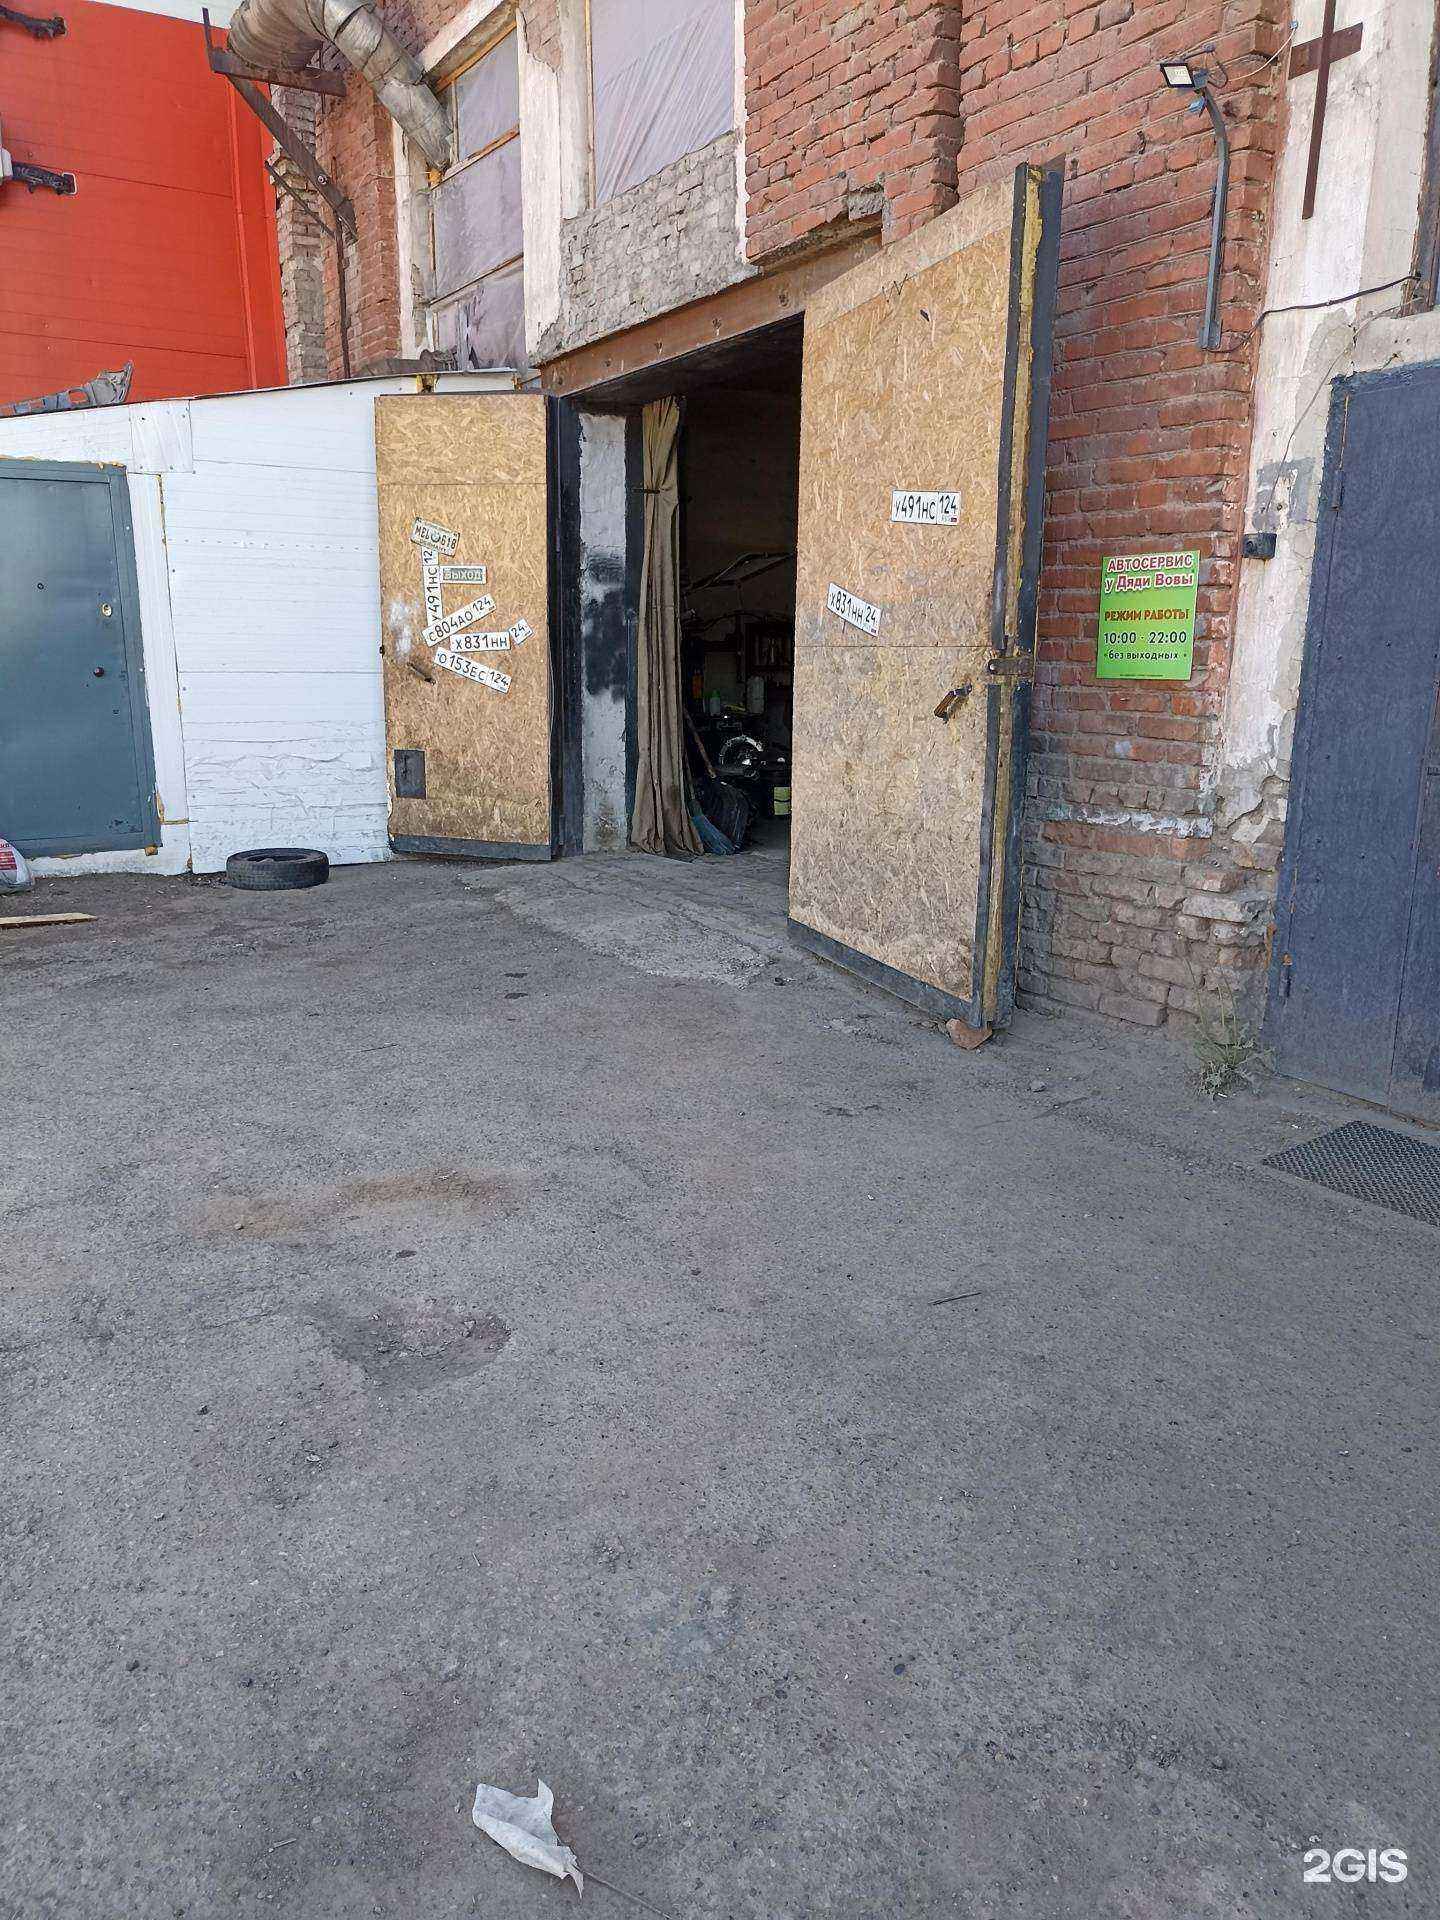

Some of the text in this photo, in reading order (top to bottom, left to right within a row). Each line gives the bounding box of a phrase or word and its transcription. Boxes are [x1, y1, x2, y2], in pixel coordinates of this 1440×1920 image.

[939, 495, 956, 514] 124
[423, 550, 433, 564] 12
[1107, 554, 1193, 572] АВТОСЕРВИС
[1105, 573, 1193, 592] у Дяди Вовы
[472, 596, 491, 612] 124
[1105, 608, 1189, 621] РЕЖИМ РАБОТЫ
[511, 623, 525, 638] 24
[1104, 632, 1136, 644] 10:00
[1149, 631, 1187, 644] 22:00
[1108, 650, 1178, 660] без выходных
[490, 671, 508, 687] 124
